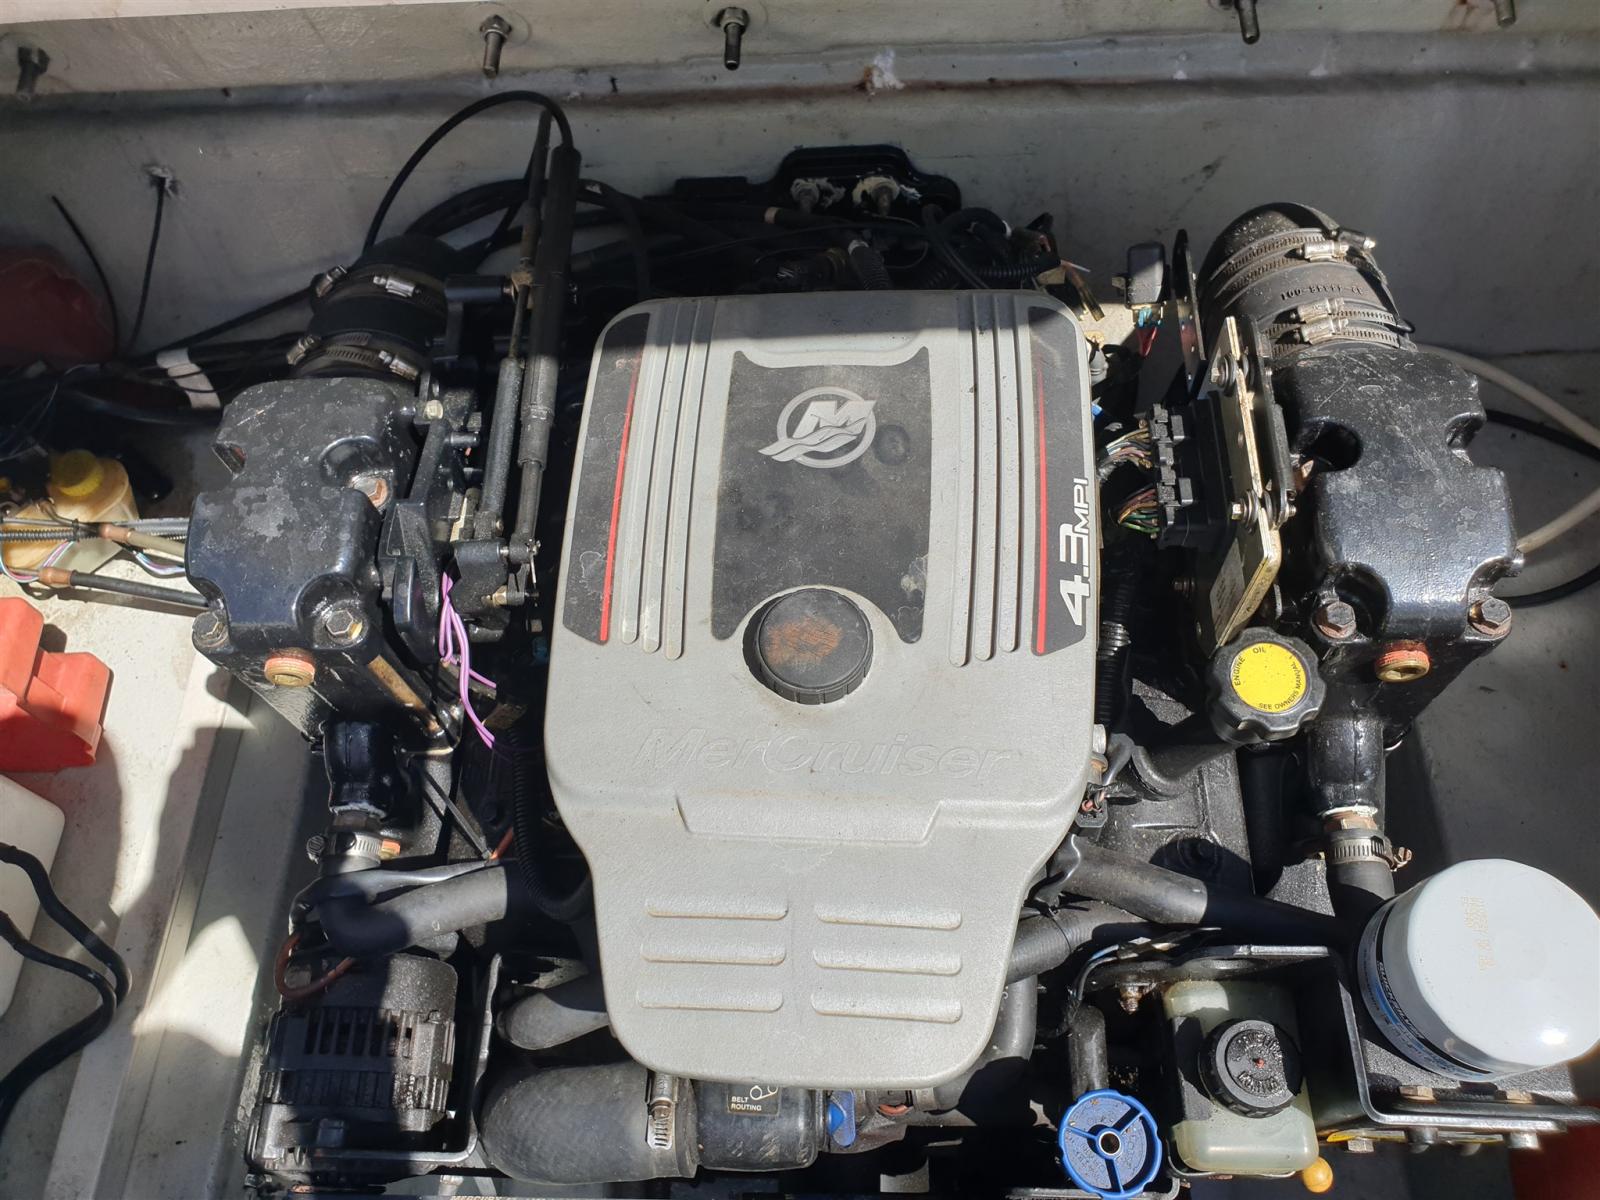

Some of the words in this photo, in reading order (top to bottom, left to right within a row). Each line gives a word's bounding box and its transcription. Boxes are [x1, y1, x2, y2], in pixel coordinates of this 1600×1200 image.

[1234, 656, 1246, 686] ENGINE
[1259, 702, 1273, 710] SEE
[1274, 690, 1299, 710] OWNERS
[1291, 661, 1302, 690] MANUAL
[631, 727, 1012, 779] MerCruiser
[730, 1103, 762, 1112] ROUTING
[731, 1095, 750, 1103] BELT
